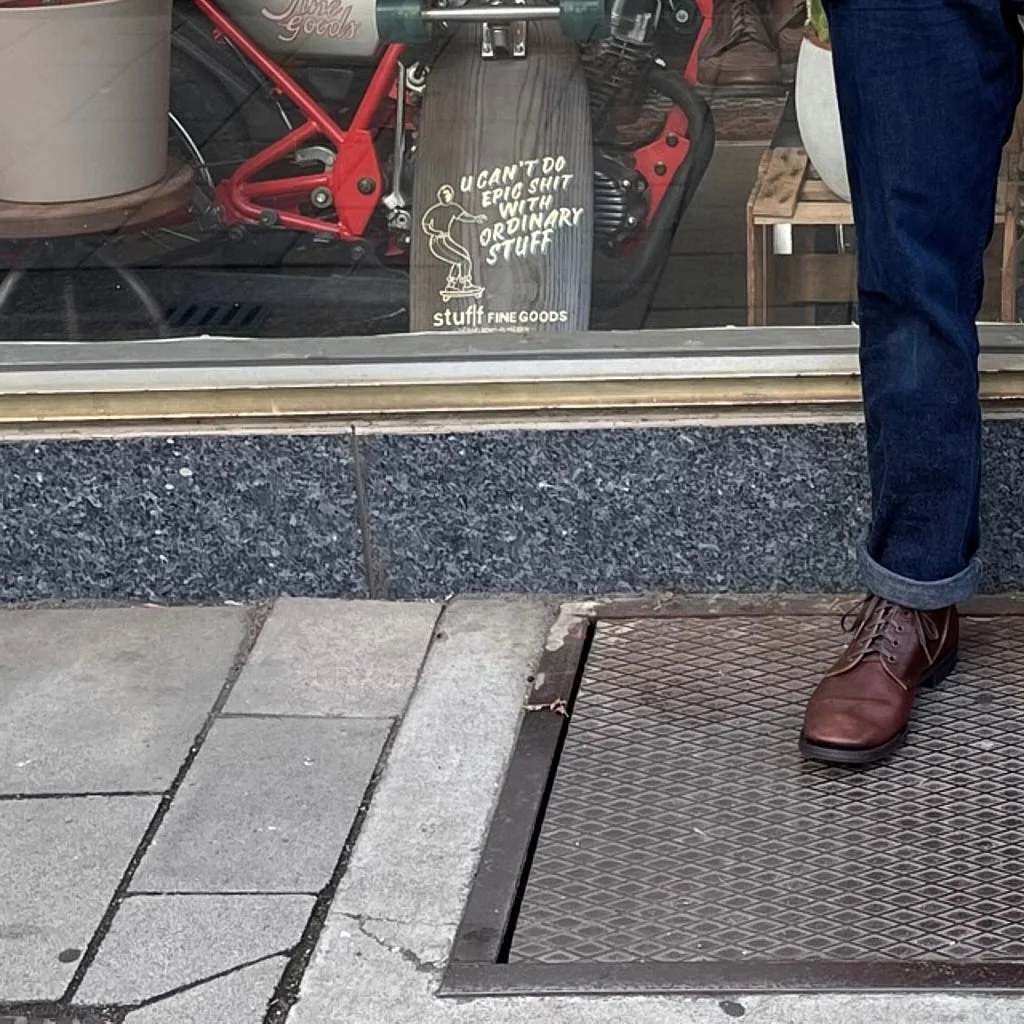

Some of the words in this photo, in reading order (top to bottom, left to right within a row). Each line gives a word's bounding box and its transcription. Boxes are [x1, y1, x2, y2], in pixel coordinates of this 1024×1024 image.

[460, 176, 472, 193] U
[476, 159, 539, 190] CAN'T
[542, 156, 566, 174] DO
[481, 182, 523, 208] EPIC
[527, 174, 574, 195] SHIT
[499, 194, 553, 219] WITH
[479, 207, 585, 247] ORDINARY
[486, 228, 554, 265] STUFF
[487, 311, 517, 324] FINE
[518, 309, 569, 323] GOODS
